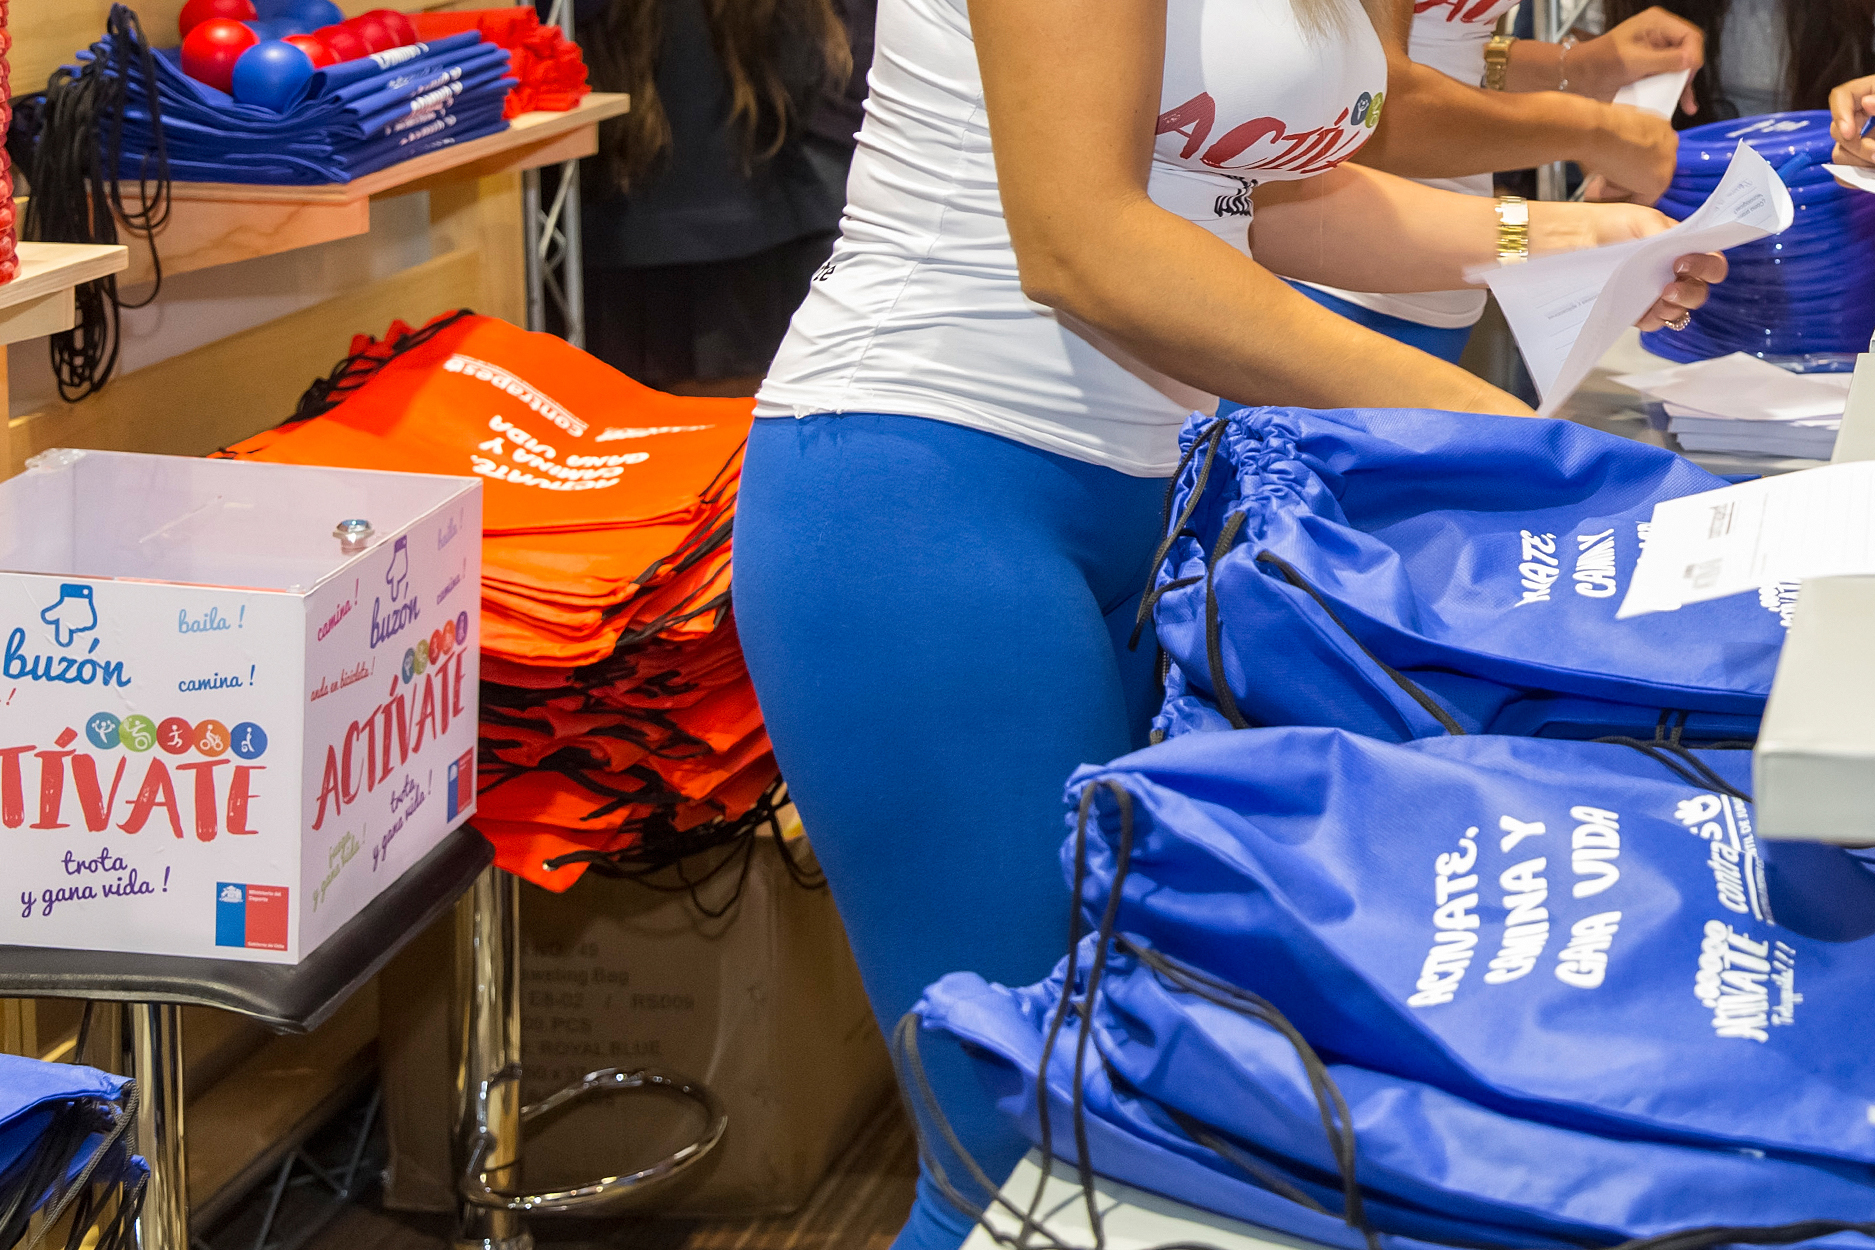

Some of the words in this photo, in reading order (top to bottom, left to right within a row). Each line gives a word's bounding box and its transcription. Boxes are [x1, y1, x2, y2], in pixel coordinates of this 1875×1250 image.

[478, 437, 505, 455] Y
[488, 414, 557, 459] VIDA
[512, 448, 625, 481] CAMINA
[566, 452, 650, 468] GANA
[178, 607, 231, 634] baila
[317, 600, 352, 642] camina
[370, 581, 420, 649] buzón
[3, 627, 131, 688] buzón
[178, 672, 243, 693] camina
[311, 646, 468, 831] ACTÍVATE
[1499, 814, 1547, 853] Y
[1569, 805, 1620, 899] VIDA
[61, 847, 128, 875] trota
[20, 891, 37, 918] y
[41, 884, 98, 917] gana
[102, 868, 155, 898] vida
[539, 1039, 601, 1057] ROYAL
[609, 1039, 662, 1057] BLUE
